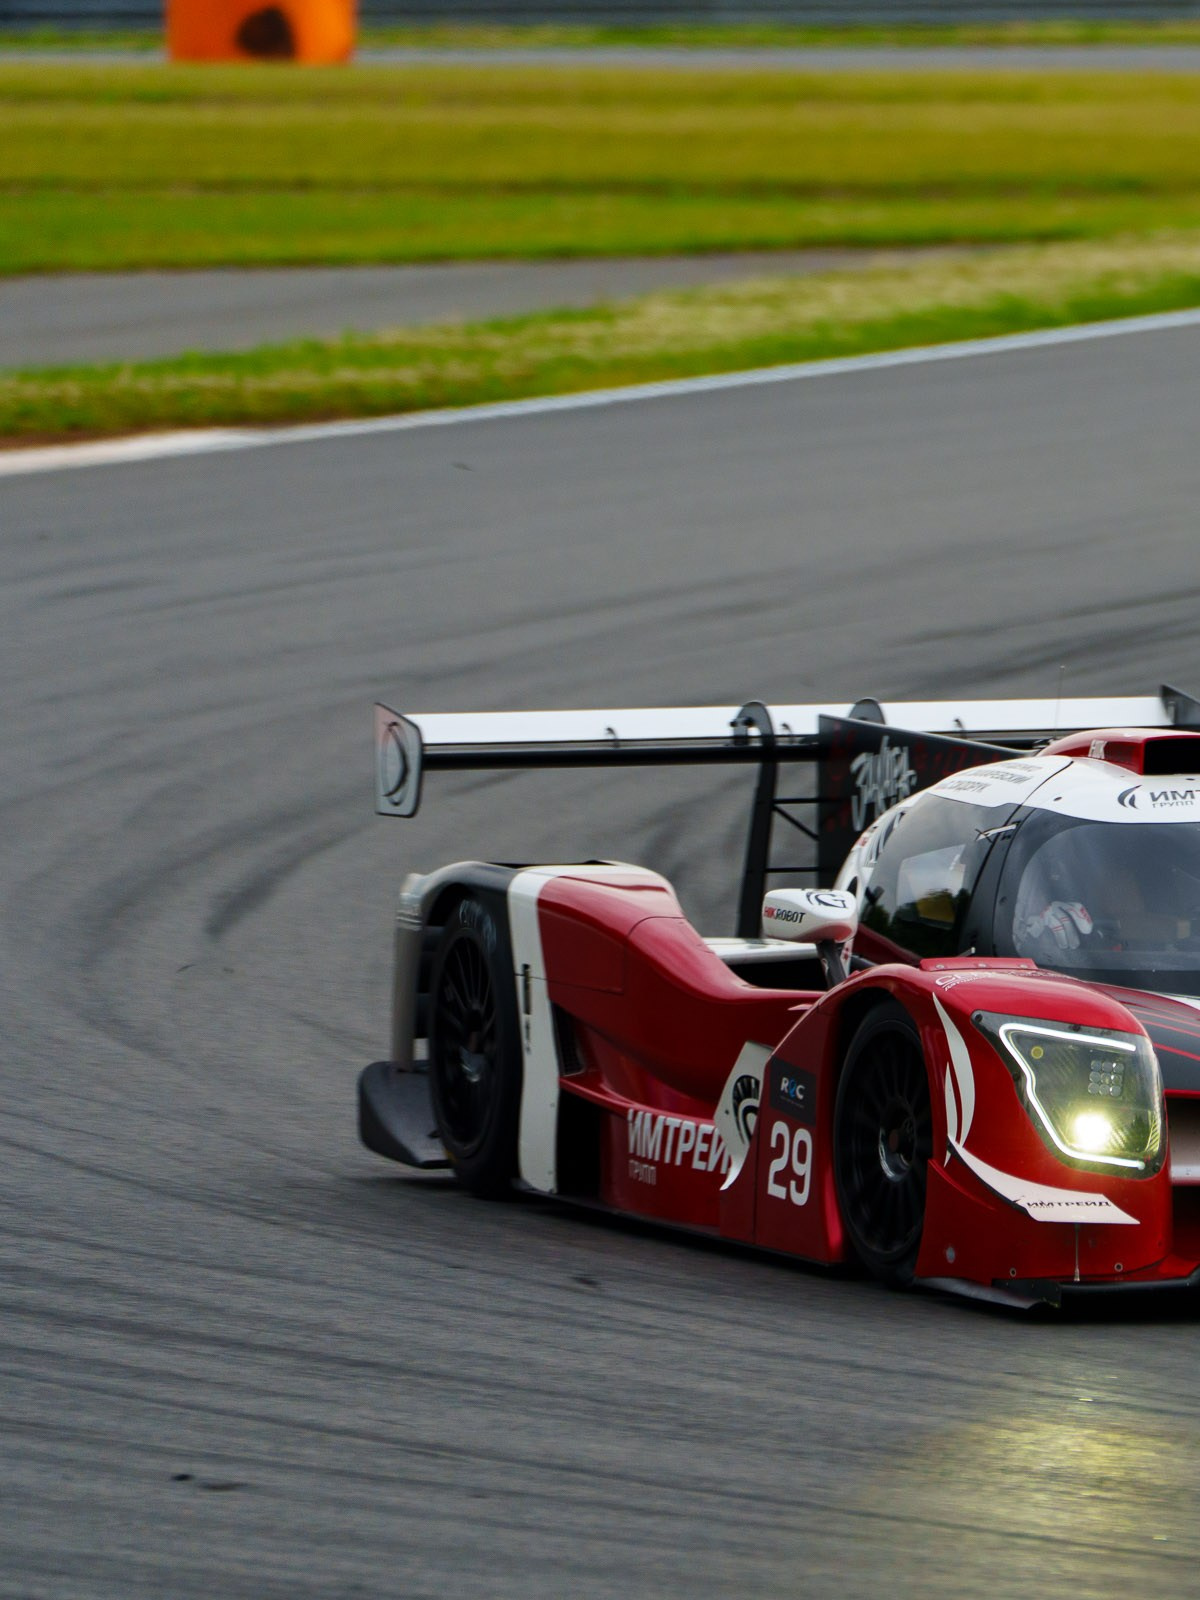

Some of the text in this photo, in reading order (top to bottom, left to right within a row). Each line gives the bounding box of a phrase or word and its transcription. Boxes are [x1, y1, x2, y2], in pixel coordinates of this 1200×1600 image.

[1152, 801, 1194, 809] ГРУПП
[763, 906, 806, 923] HIKROBOT
[767, 1120, 813, 1207] 29
